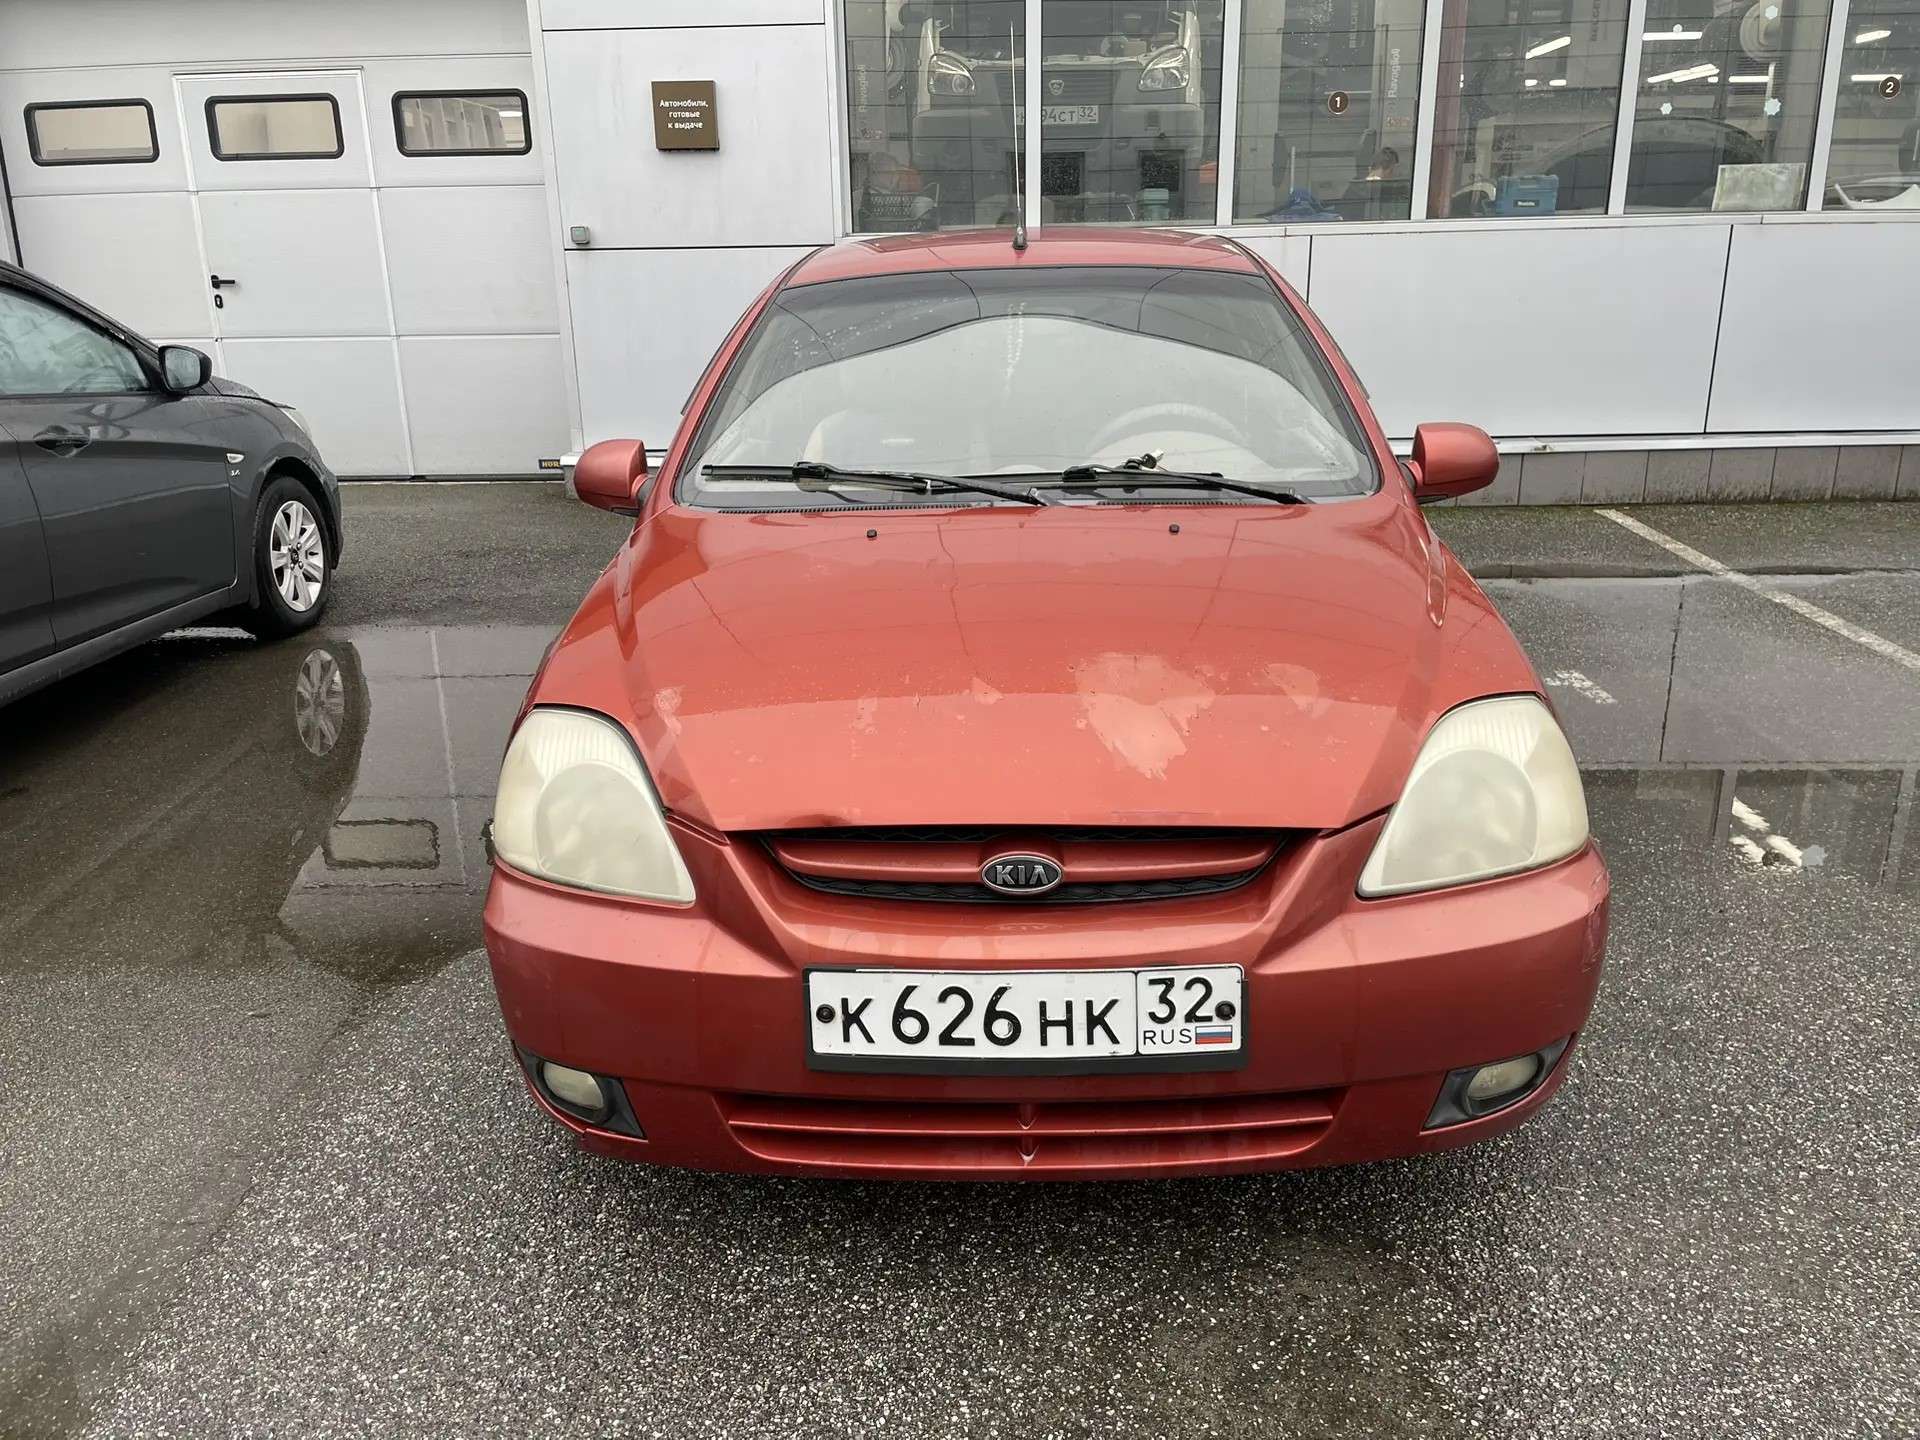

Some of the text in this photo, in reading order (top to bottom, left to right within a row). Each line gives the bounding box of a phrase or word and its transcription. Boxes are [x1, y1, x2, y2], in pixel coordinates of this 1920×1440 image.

[1885, 81, 1894, 93] 2
[659, 99, 709, 107] Автомобили,
[1335, 96, 1341, 108] 1
[674, 122, 703, 130] выдаче
[995, 865, 1049, 885] KIA
[1147, 976, 1214, 1025] 32
[1142, 1027, 1194, 1047] RUS
